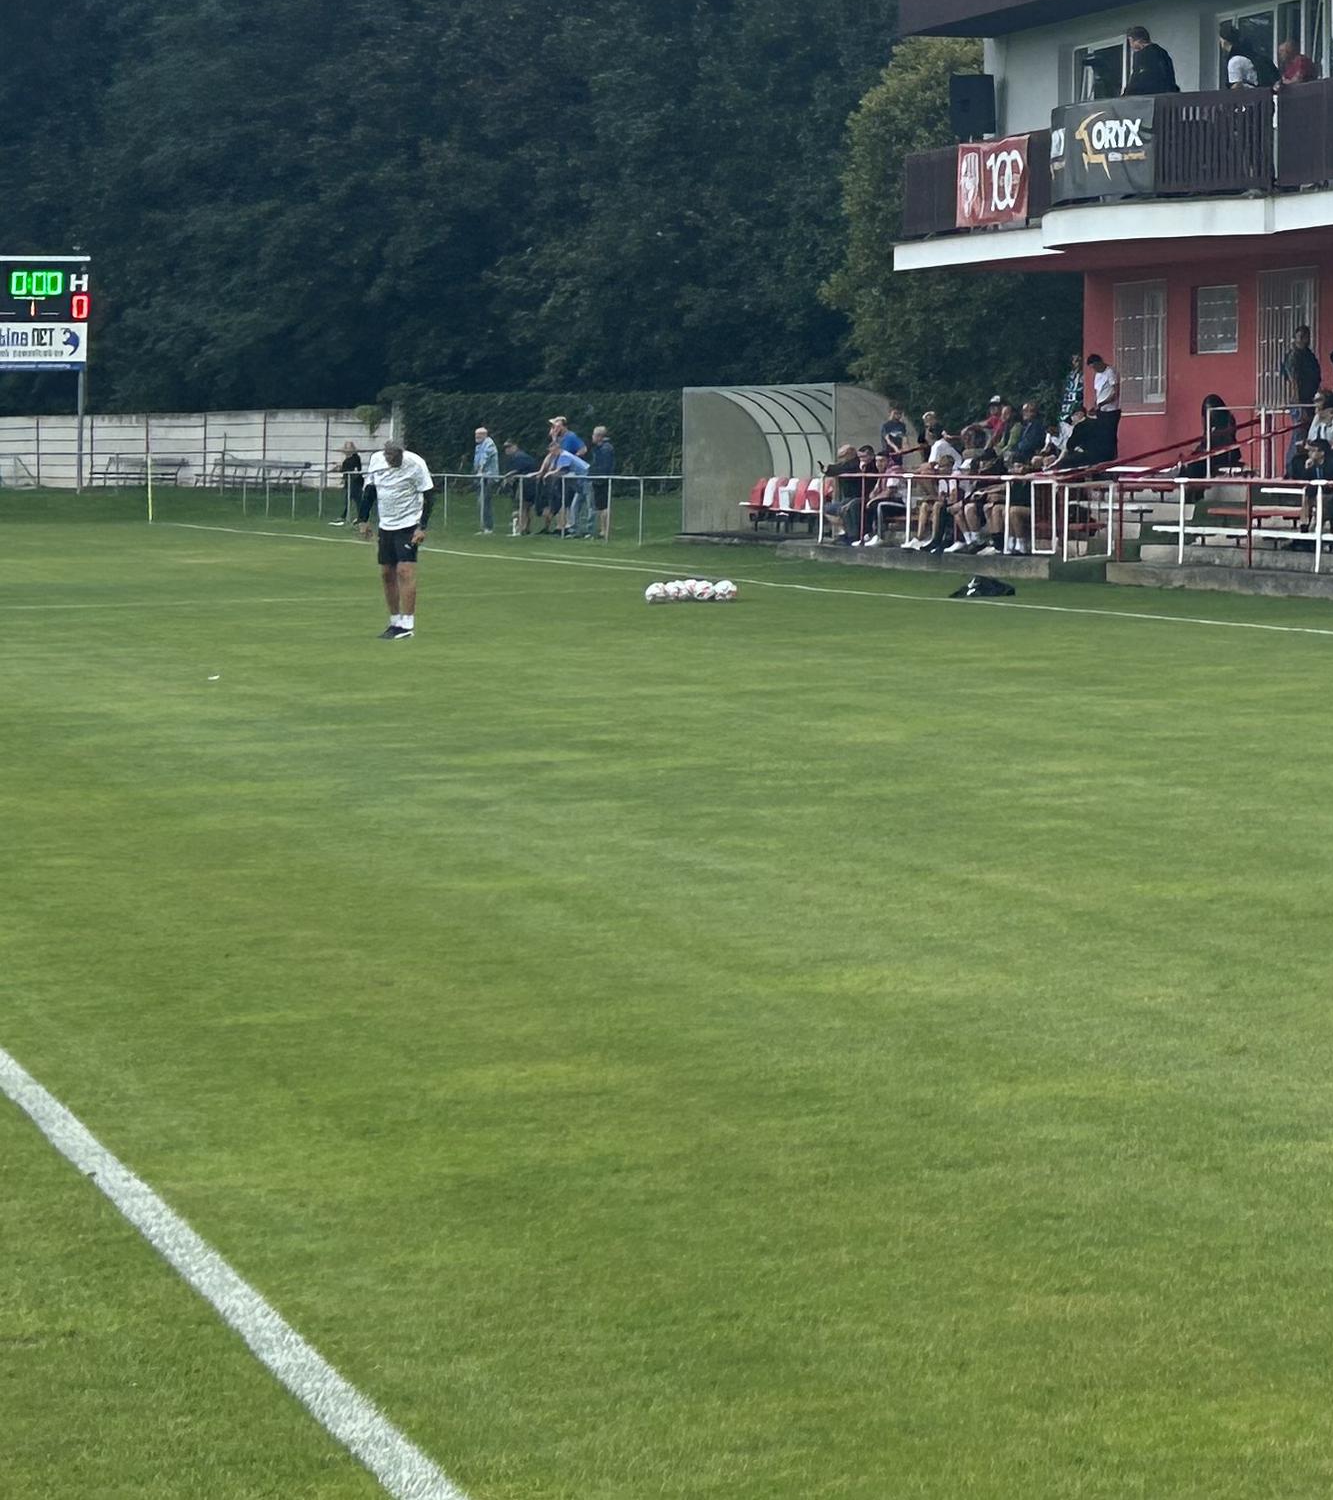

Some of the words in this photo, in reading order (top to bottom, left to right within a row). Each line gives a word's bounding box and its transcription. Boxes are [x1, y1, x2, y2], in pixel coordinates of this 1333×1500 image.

[1091, 118, 1144, 151] ORYX
[986, 149, 1025, 213] 100
[72, 295, 89, 319] 0
